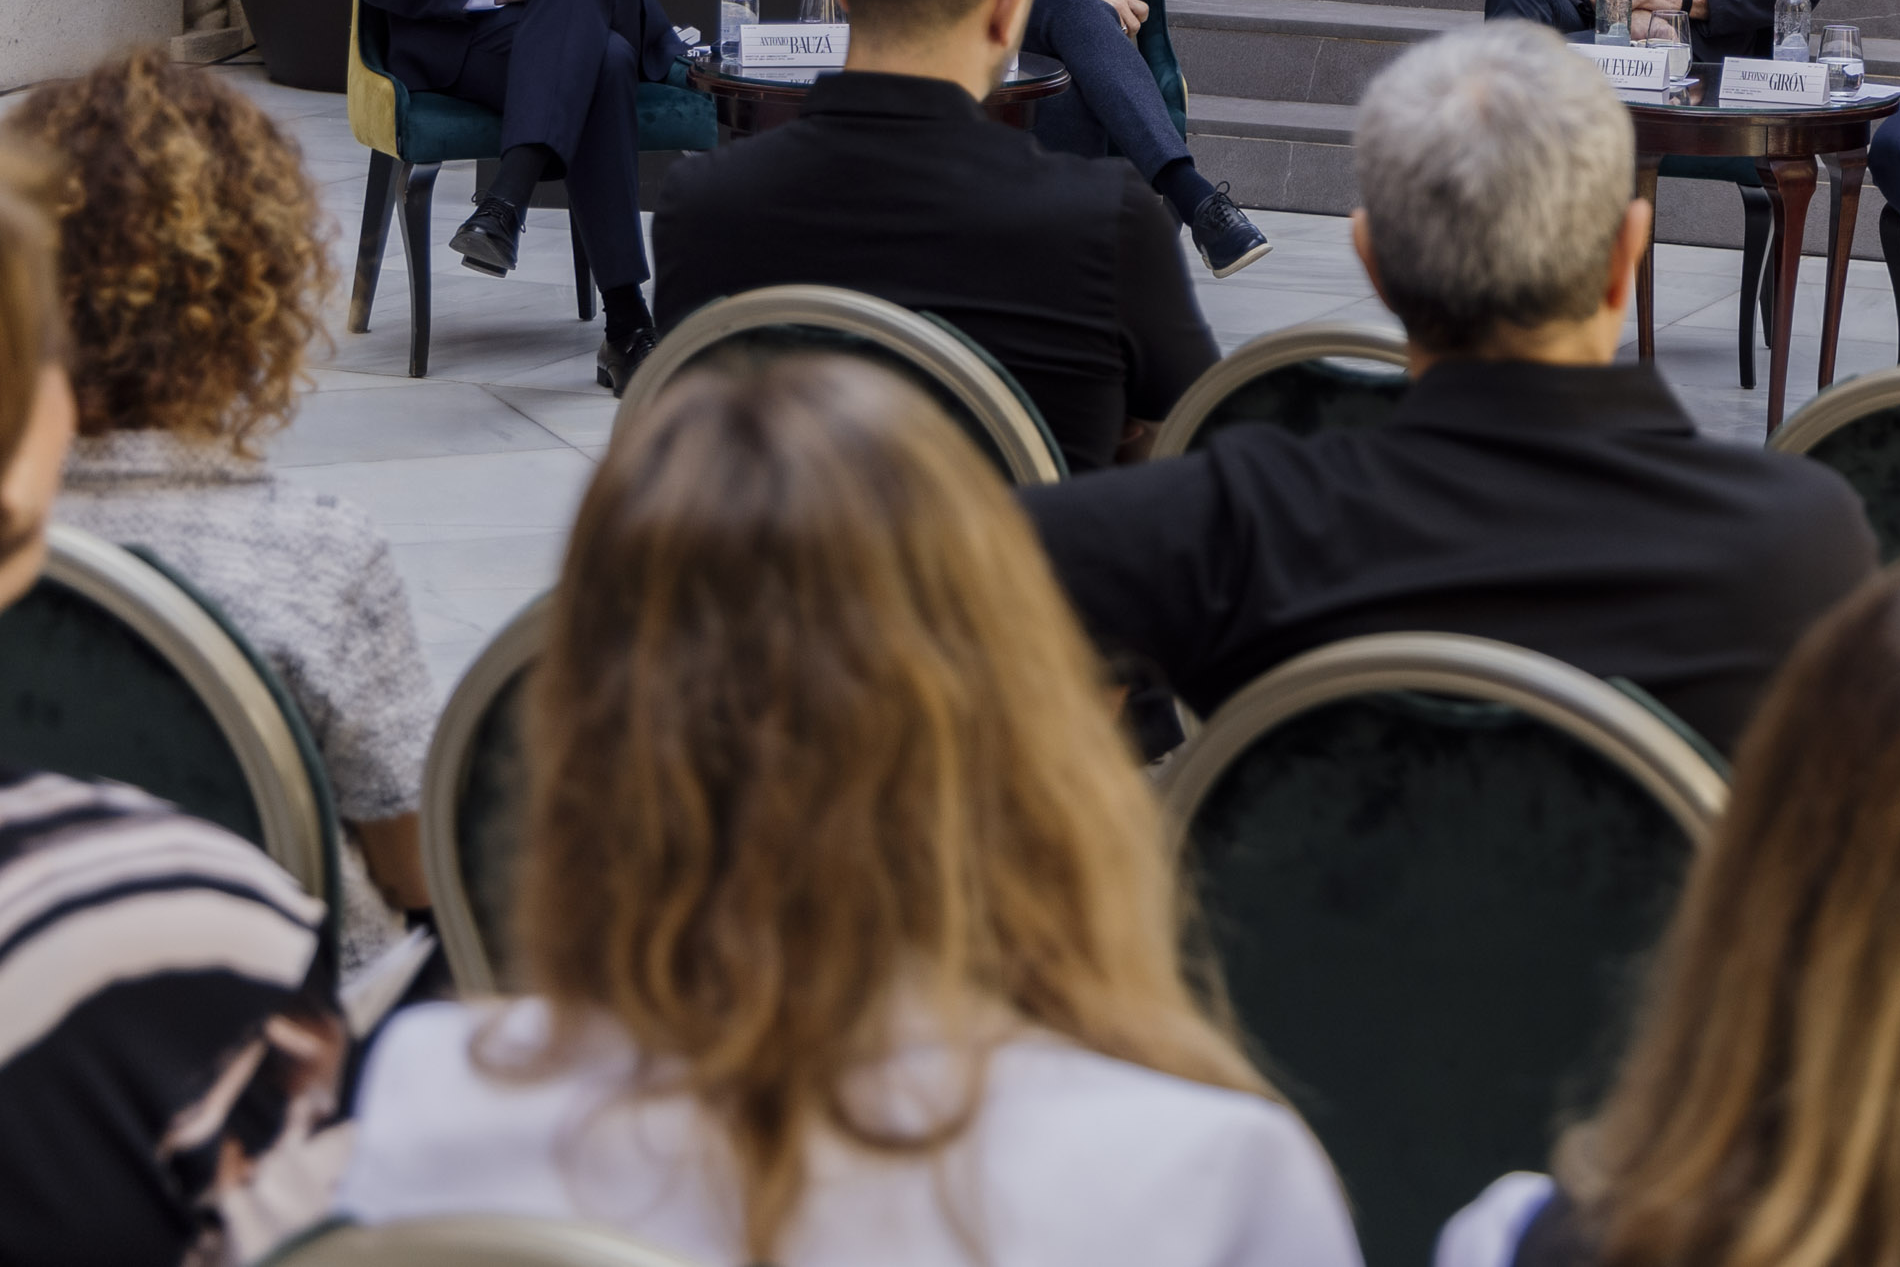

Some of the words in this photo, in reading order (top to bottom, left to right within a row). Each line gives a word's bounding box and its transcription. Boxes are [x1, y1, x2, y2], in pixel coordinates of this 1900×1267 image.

[760, 36, 789, 46] ANTONIO
[790, 33, 833, 54] BAUZÁ
[1741, 71, 1769, 81] ALFONSO
[1769, 72, 1807, 92] GIRÓN
